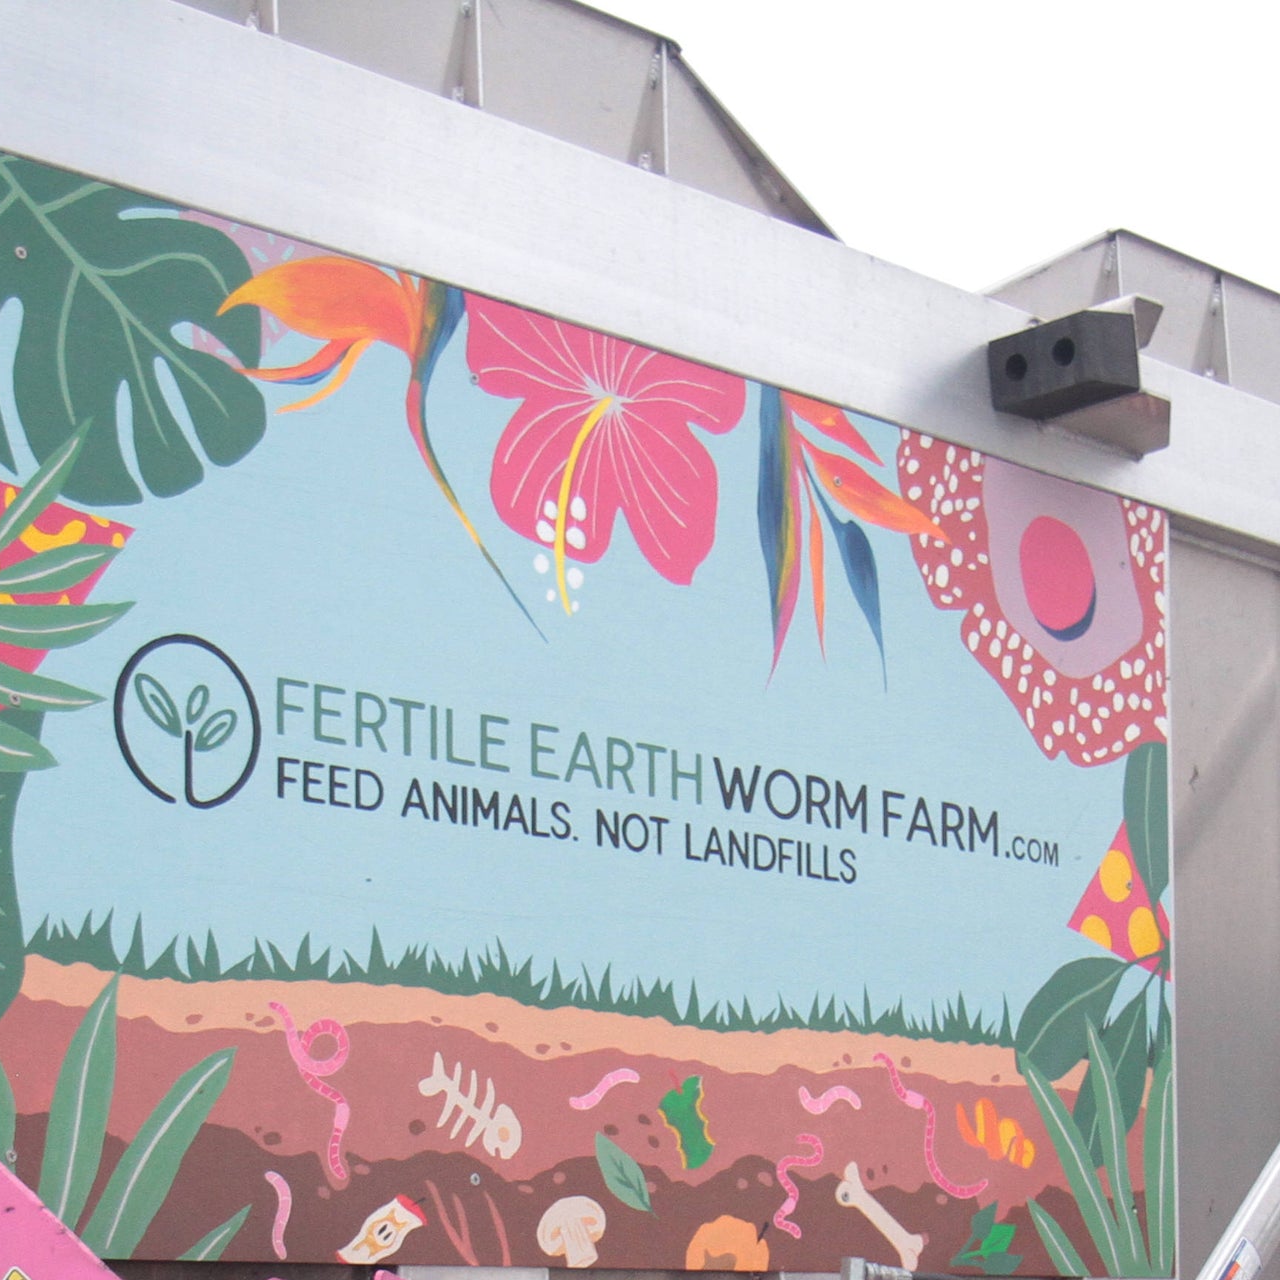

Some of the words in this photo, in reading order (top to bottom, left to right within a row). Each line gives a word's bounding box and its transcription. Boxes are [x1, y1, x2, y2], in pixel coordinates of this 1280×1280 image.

[276, 676, 510, 773] FERTILE
[530, 722, 703, 806] EARTH
[713, 756, 868, 835] WORM
[277, 756, 384, 812] FEED
[401, 777, 579, 842] ANIMALS.
[596, 808, 670, 856] NOT
[685, 822, 857, 885] LANDFILLS
